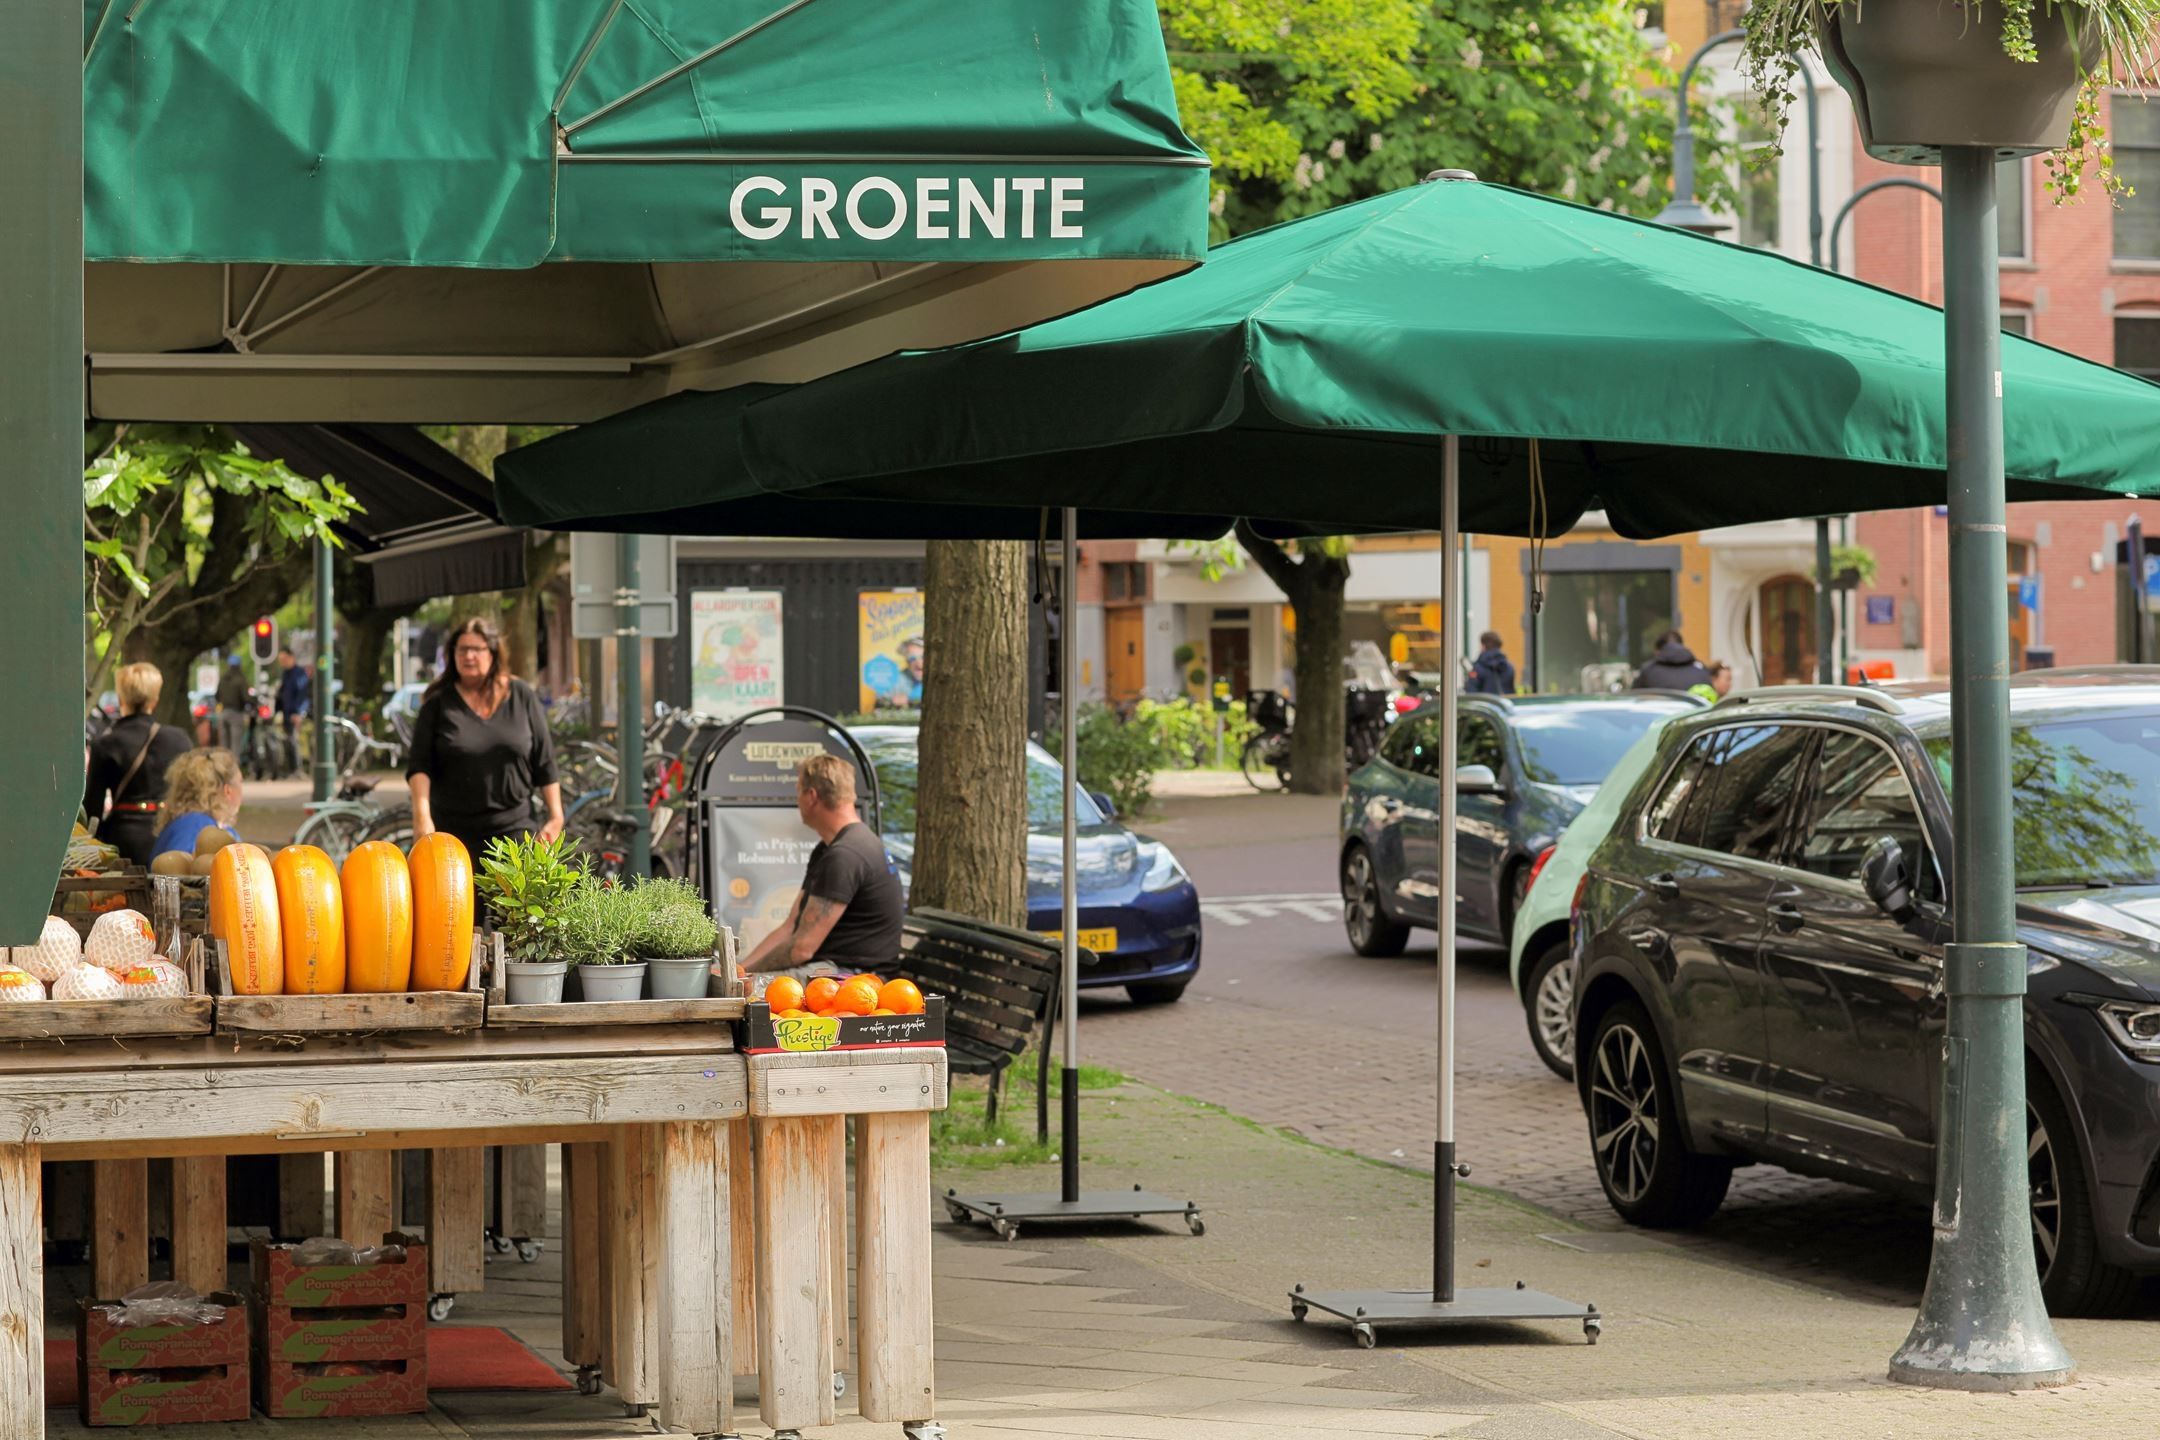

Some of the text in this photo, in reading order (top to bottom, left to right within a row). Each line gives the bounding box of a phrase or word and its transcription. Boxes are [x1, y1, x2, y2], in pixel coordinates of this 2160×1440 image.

[729, 176, 1084, 240] GROENTE
[771, 838, 797, 852] Prijs
[775, 1020, 841, 1050] Prestige
[306, 1278, 395, 1291] Pomegranates
[119, 1338, 213, 1352] Pomegranates
[304, 1333, 394, 1345] Pomegranates
[121, 1393, 214, 1407] Pomegranates
[303, 1388, 393, 1401] Pomegranates
